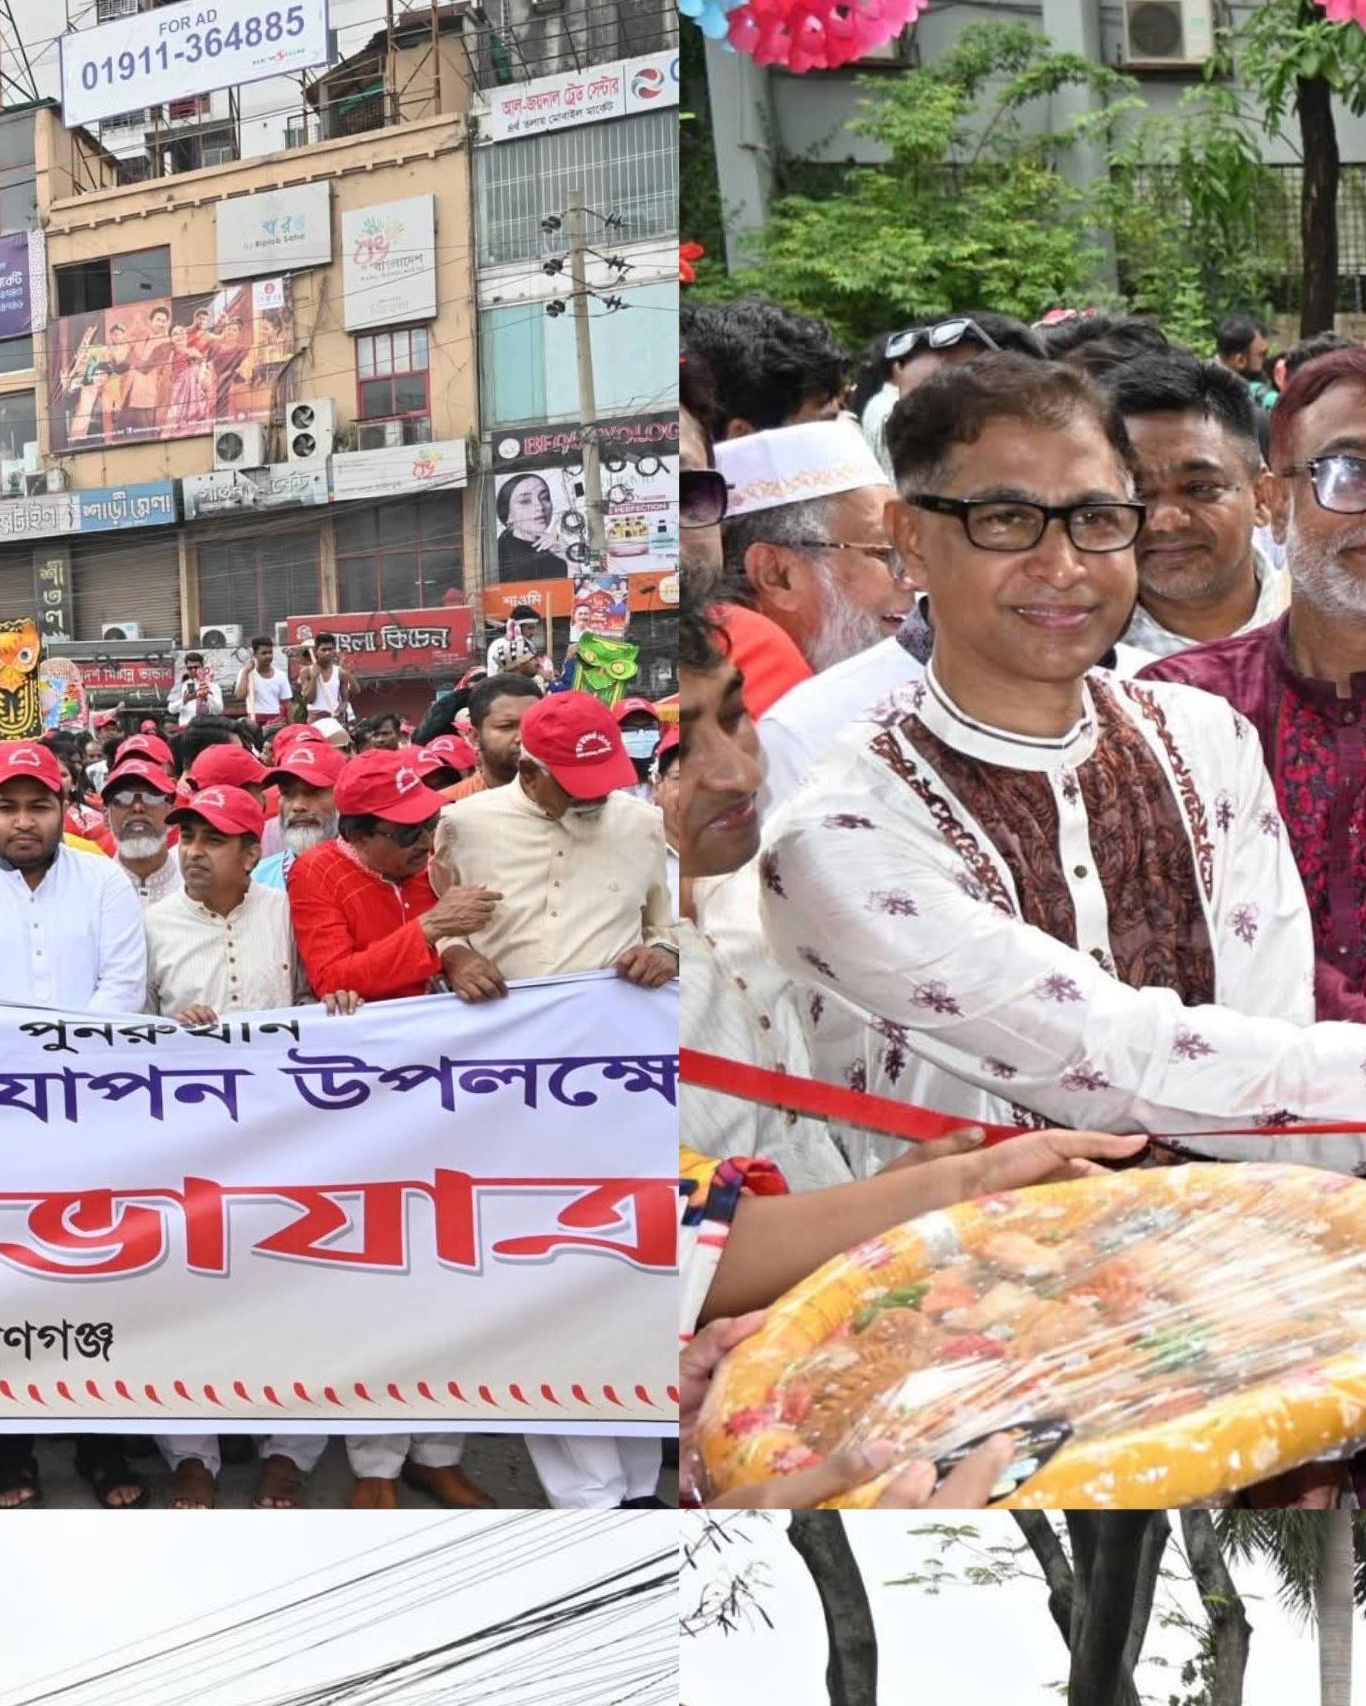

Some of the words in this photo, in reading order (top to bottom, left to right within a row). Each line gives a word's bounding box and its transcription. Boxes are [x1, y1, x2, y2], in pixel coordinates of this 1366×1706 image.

[158, 16, 191, 36] FOR
[195, 9, 218, 27] AD
[81, 4, 305, 91] 01911-364885
[564, 82, 585, 107] ট্রেড
[587, 75, 620, 101] সেন্টার
[319, 630, 377, 653] াংলা
